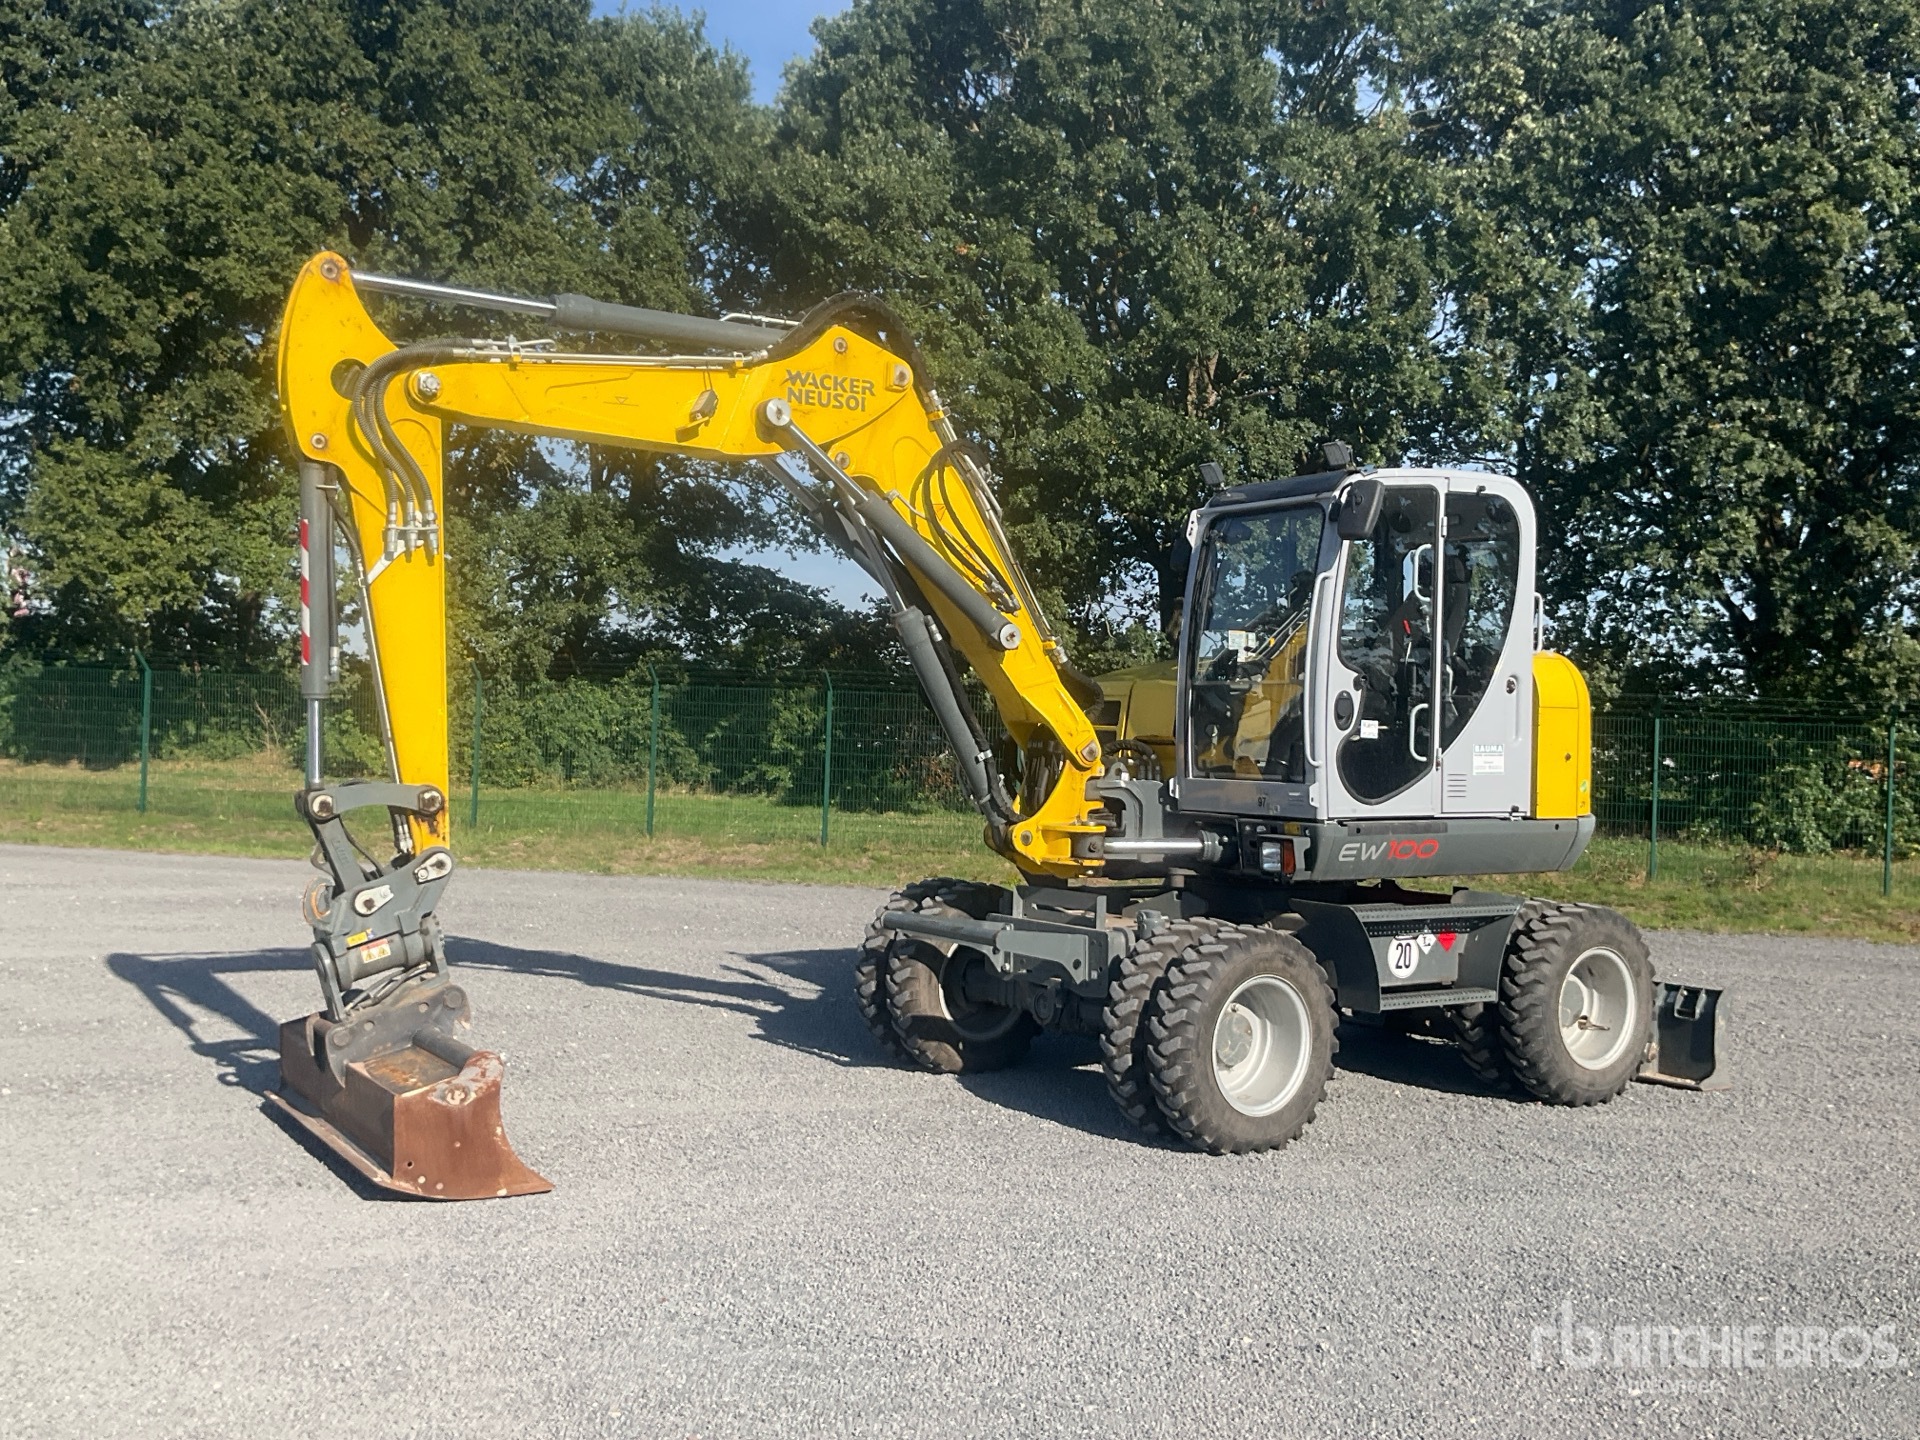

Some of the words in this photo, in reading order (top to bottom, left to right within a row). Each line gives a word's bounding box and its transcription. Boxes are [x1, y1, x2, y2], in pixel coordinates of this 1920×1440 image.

[780, 369, 876, 396] WACKER
[1338, 838, 1439, 861] EW100
[1395, 943, 1412, 969] 20
